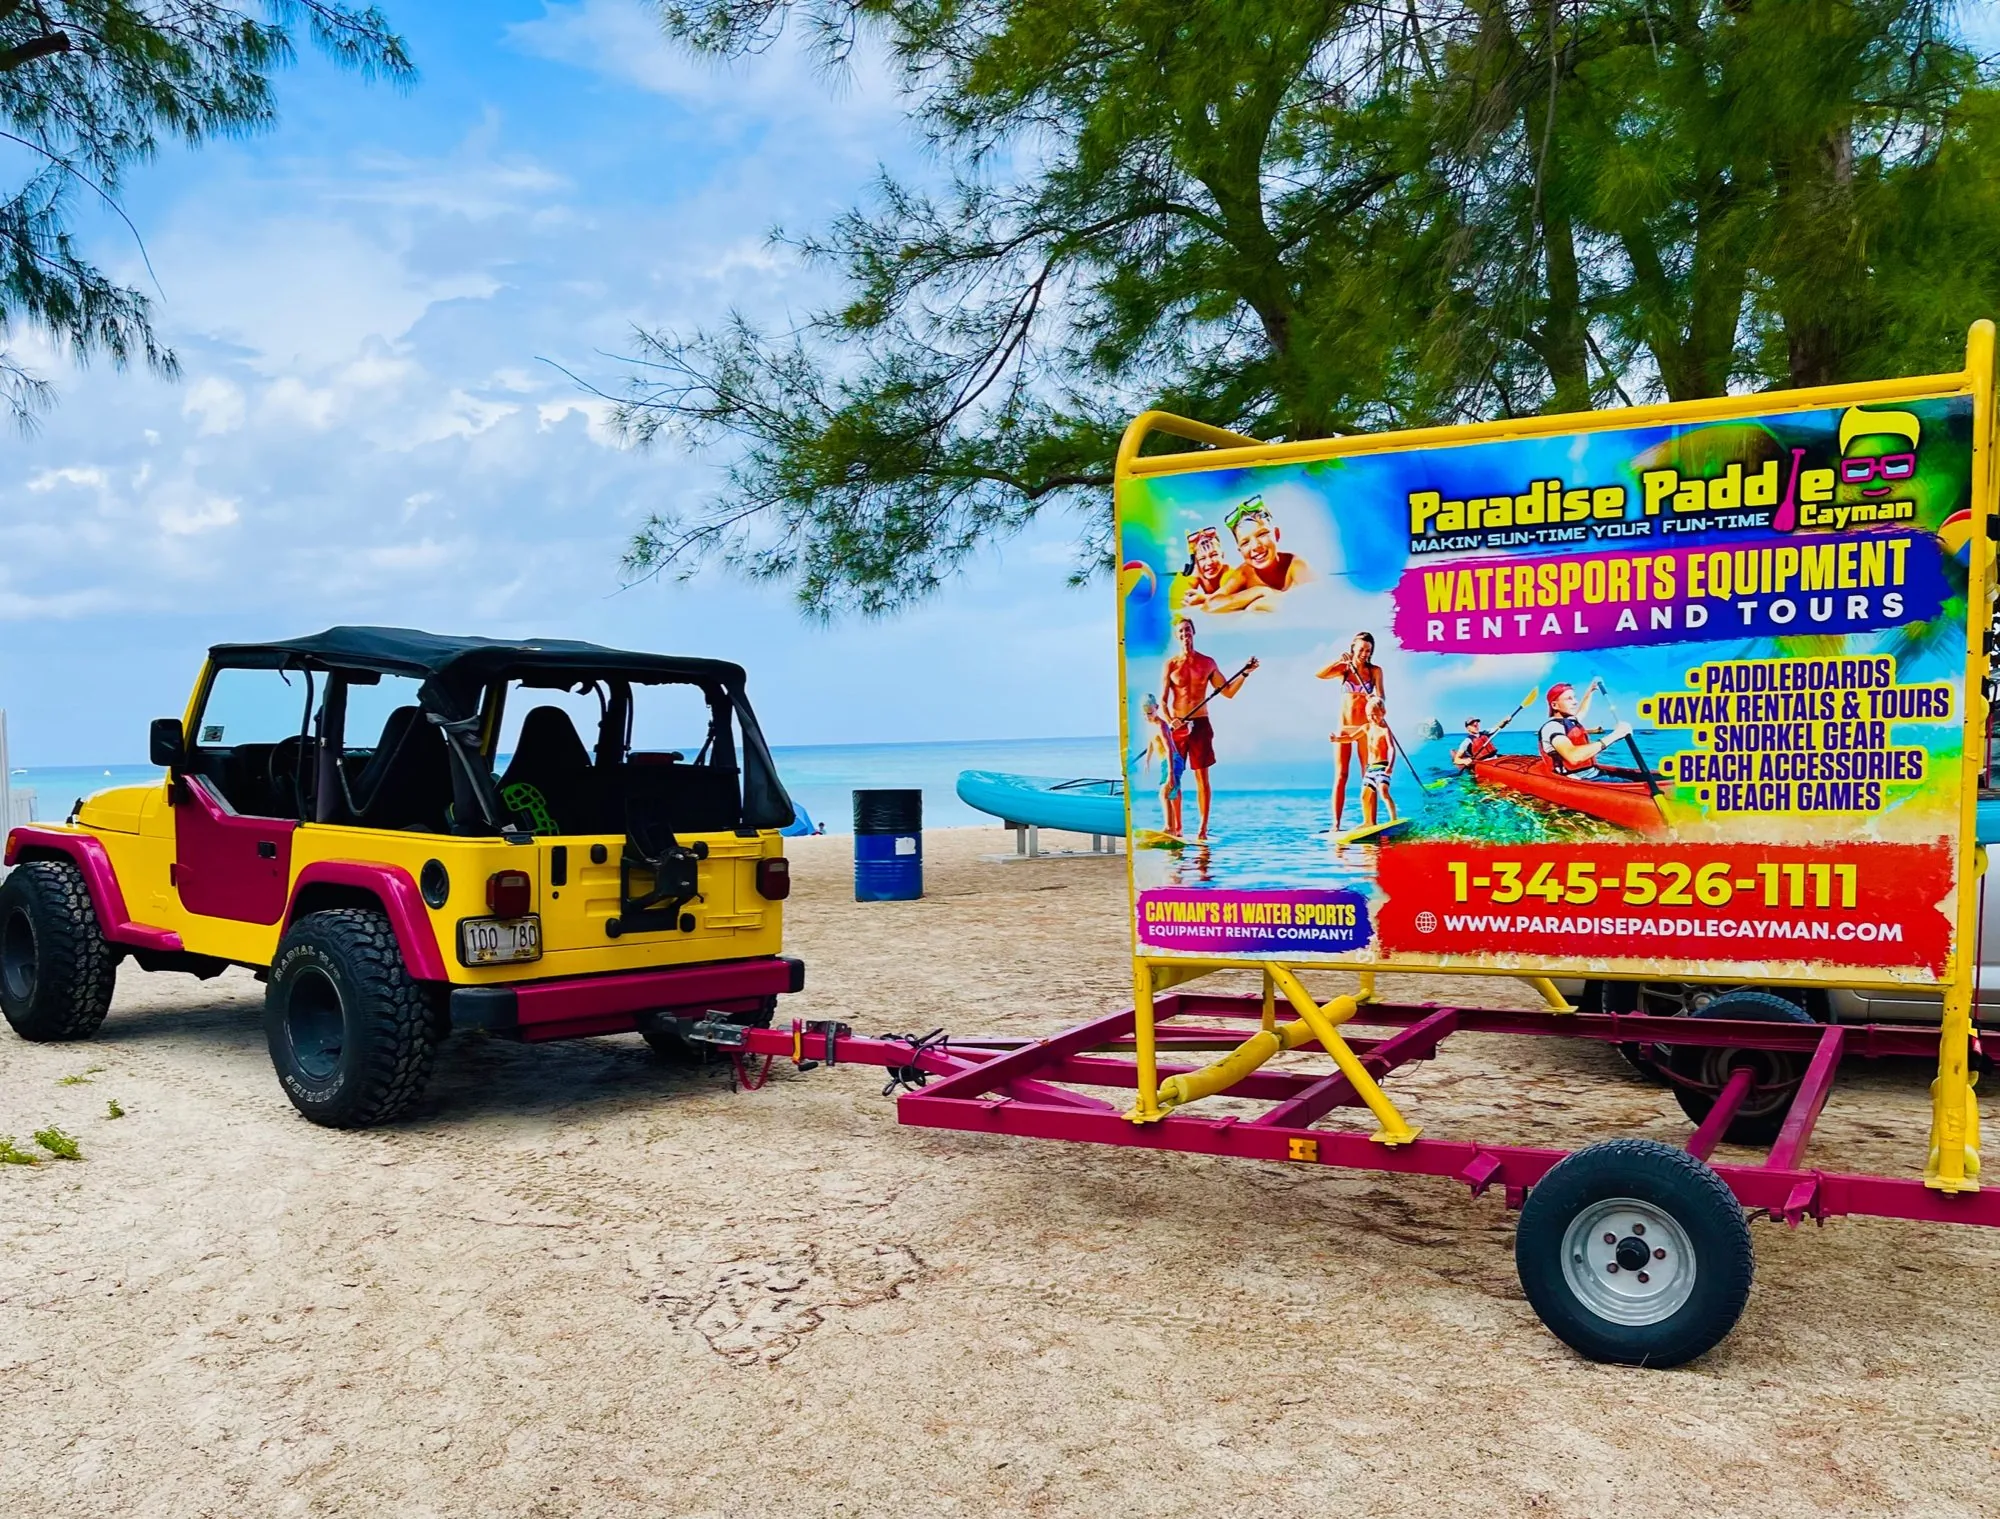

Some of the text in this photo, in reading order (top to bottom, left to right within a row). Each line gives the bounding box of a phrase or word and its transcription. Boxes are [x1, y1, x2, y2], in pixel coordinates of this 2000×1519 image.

[1409, 450, 1834, 534] Paradise Paddle
[1800, 500, 1913, 529] Cayman
[1411, 512, 1769, 553] MAKIN' SUN-TIME YOUR FUN-TIME
[1423, 538, 1912, 613] WATERSPORTS EQUIPMENT
[1427, 592, 1904, 642] RENTAL AND TOURS
[1706, 658, 1890, 694] PADDLEBOARDS
[1658, 687, 1949, 725] KAYAK RENTALS & TOURS
[1713, 721, 1885, 753] SNORKEL GEAR
[1680, 750, 1922, 782] BEACH ACCESSORIES
[1716, 782, 1881, 811] BEACH GAMES
[1448, 861, 1857, 908] 1-345-526-1111
[1145, 901, 1356, 926] CAYMAN'S #1 WATER SPORTS
[1443, 914, 1902, 942] WWW.PARADISEPADDLECAYMAN.COM
[470, 925, 537, 951] 100 780
[1149, 925, 1353, 940] EQUIPMENT RENTAL COMPANY!
